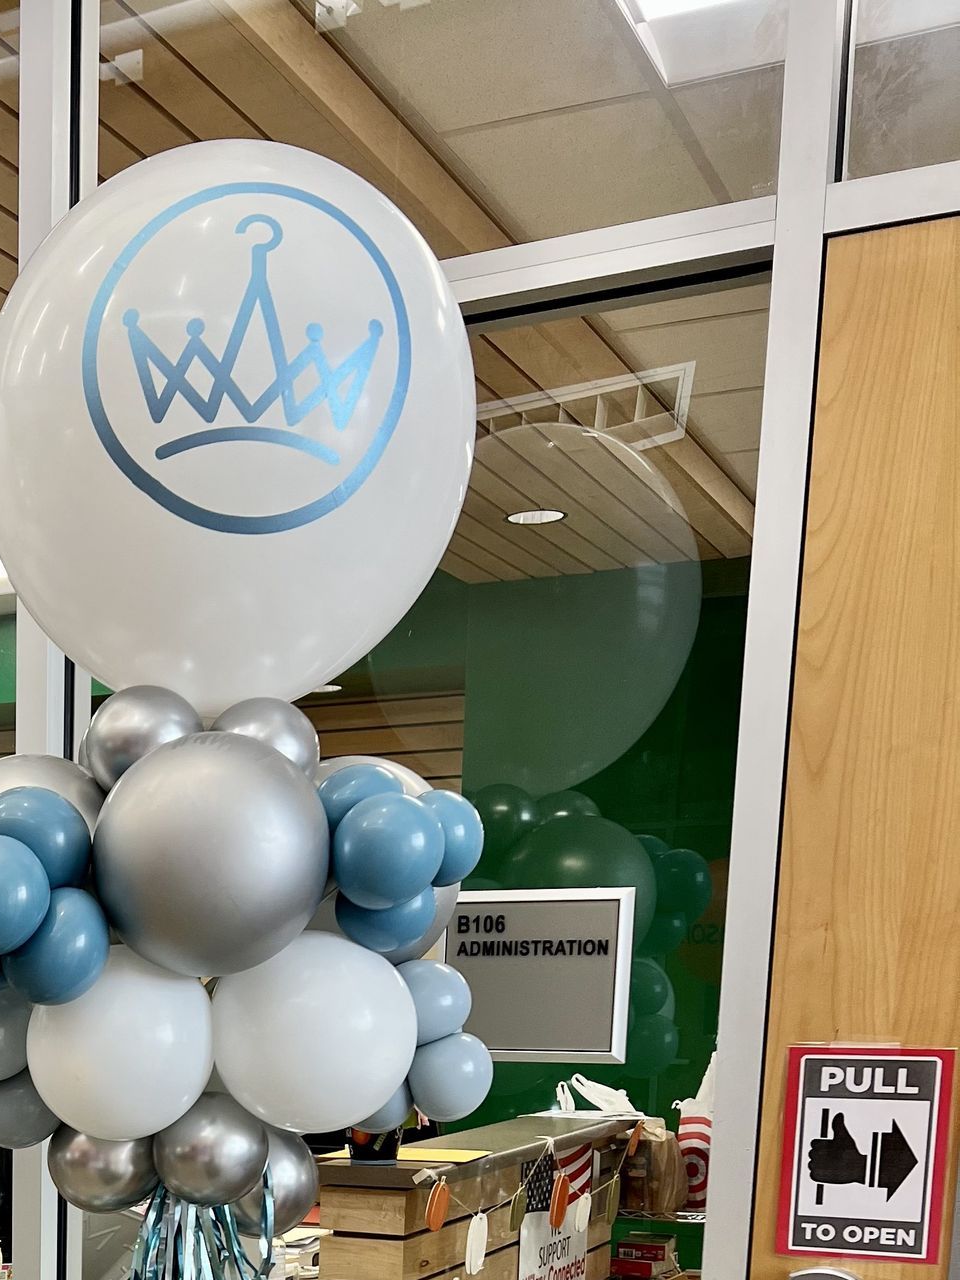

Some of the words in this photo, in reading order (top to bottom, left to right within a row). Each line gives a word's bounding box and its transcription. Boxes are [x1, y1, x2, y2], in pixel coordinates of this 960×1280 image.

[457, 914, 506, 934] B106
[456, 939, 609, 957] ADMINISTRATION
[819, 1066, 919, 1094] PULL
[801, 1222, 836, 1242] TO
[842, 1225, 916, 1247] OPEN
[538, 1236, 571, 1269] SUPPORT
